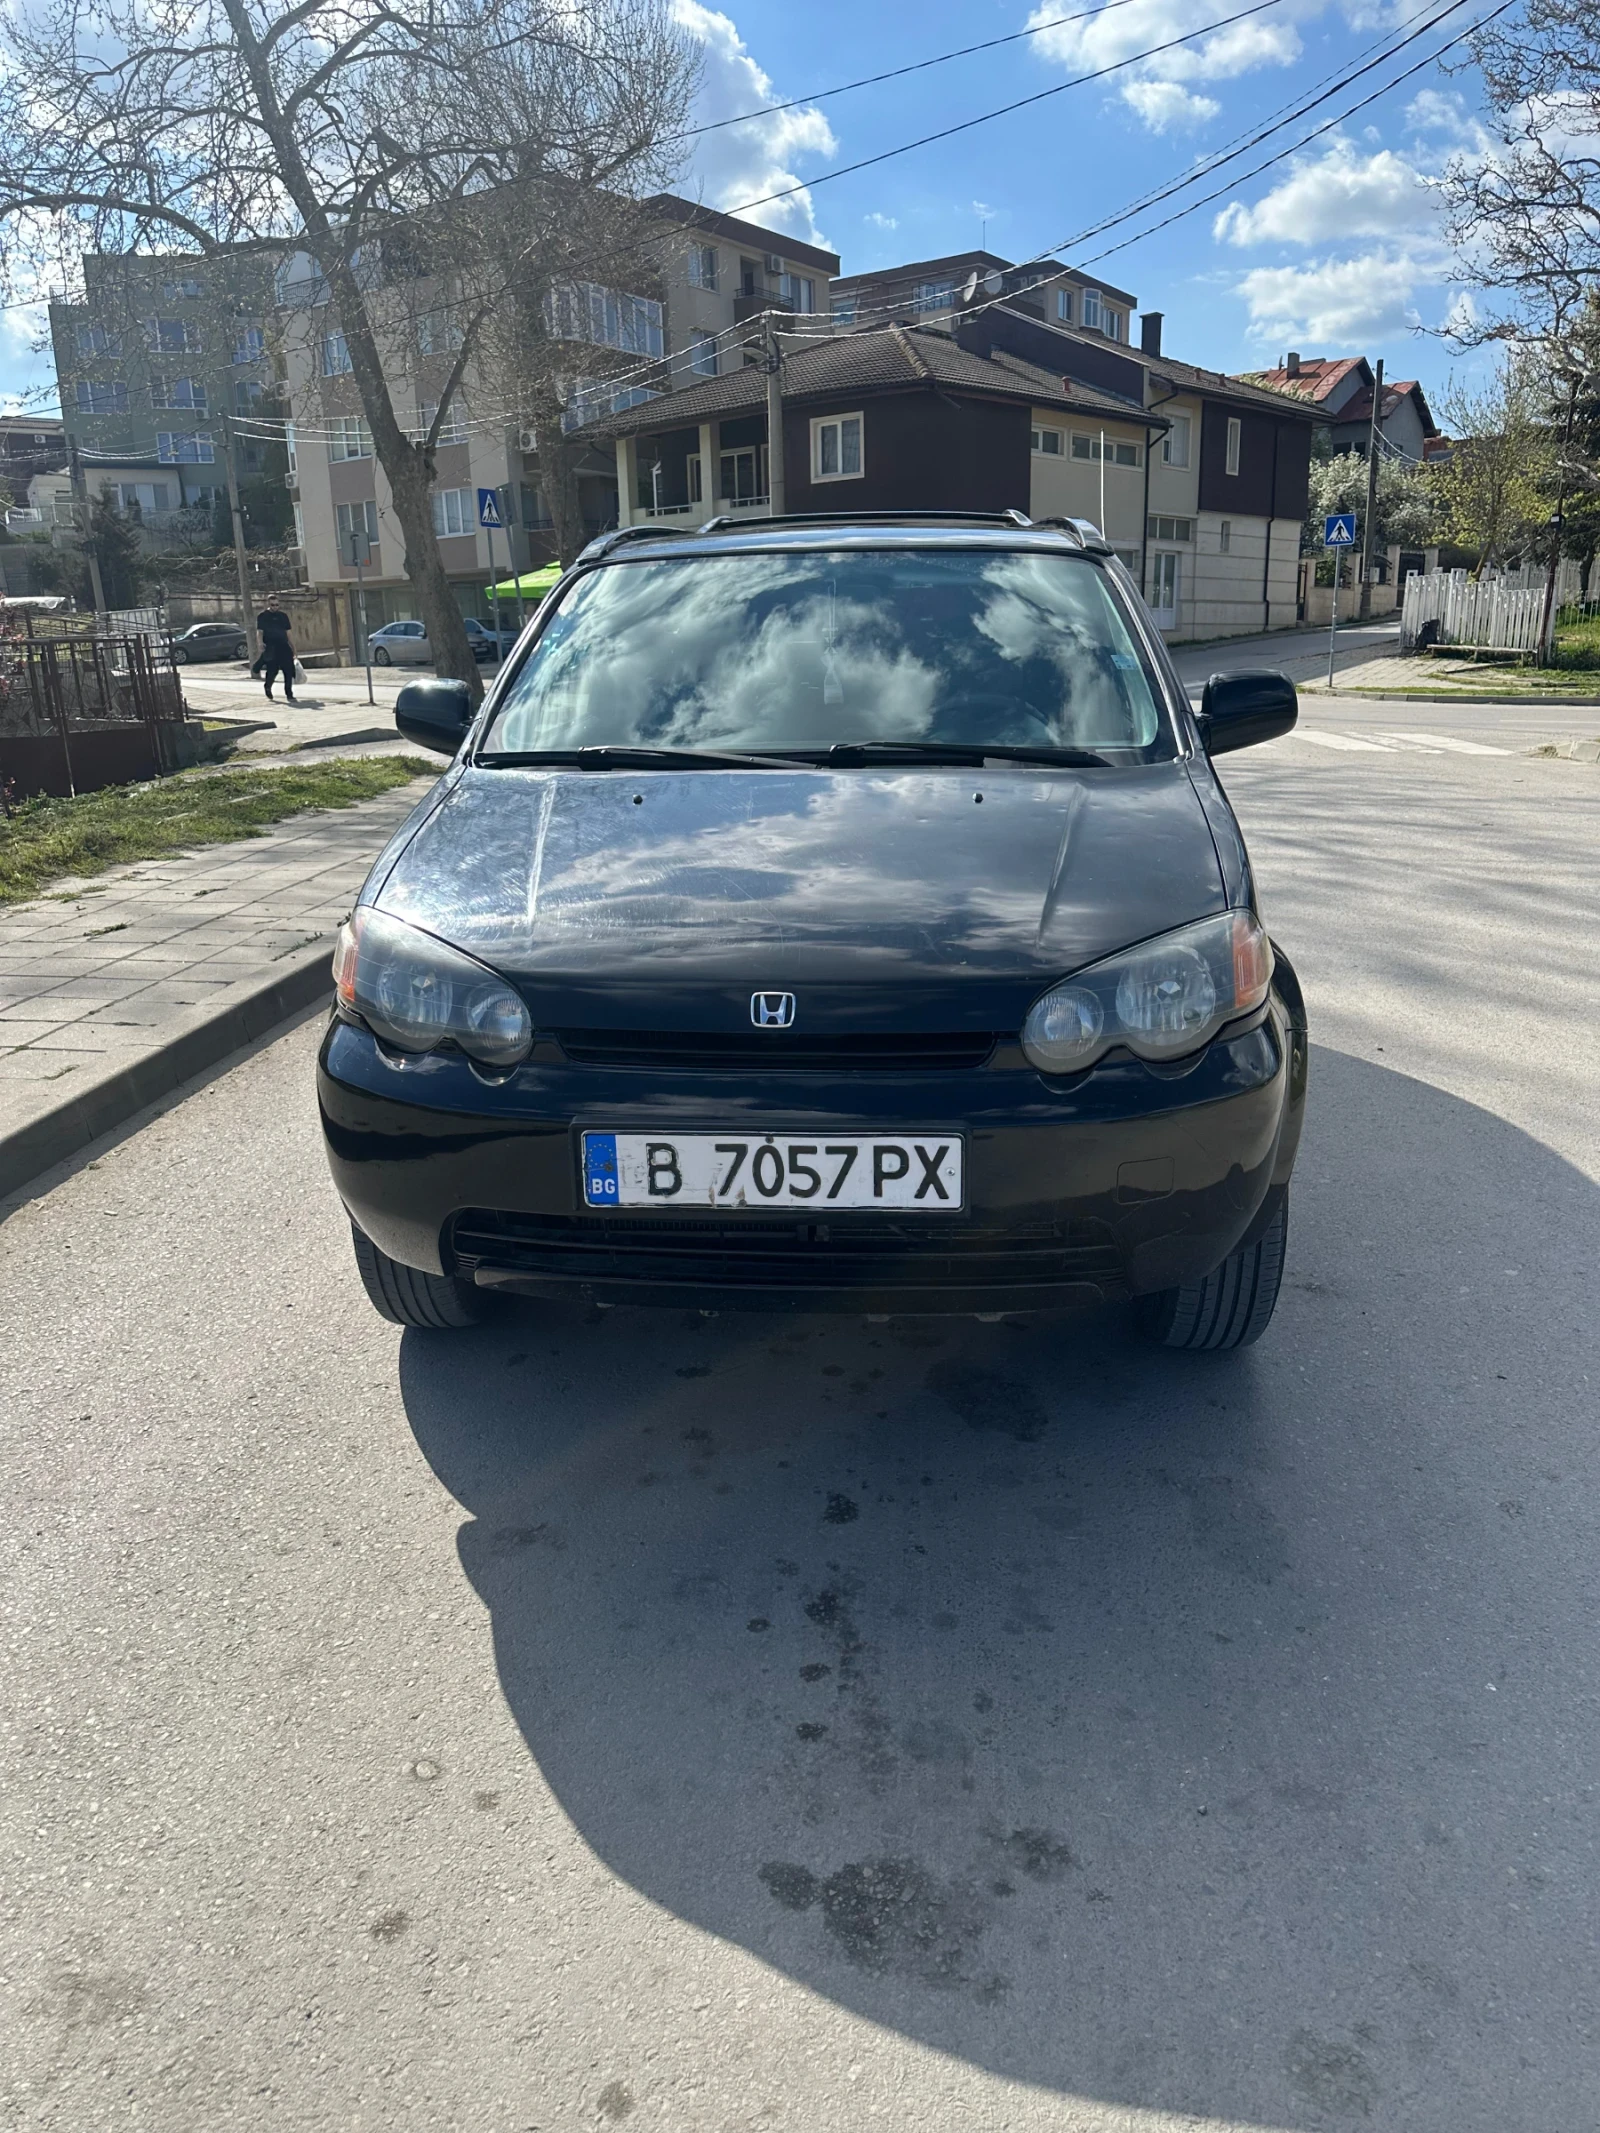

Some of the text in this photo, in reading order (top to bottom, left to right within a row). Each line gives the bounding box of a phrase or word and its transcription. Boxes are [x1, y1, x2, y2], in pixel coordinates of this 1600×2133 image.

[592, 1178, 616, 1195] BG
[646, 1142, 950, 1200] B 7057 PX
